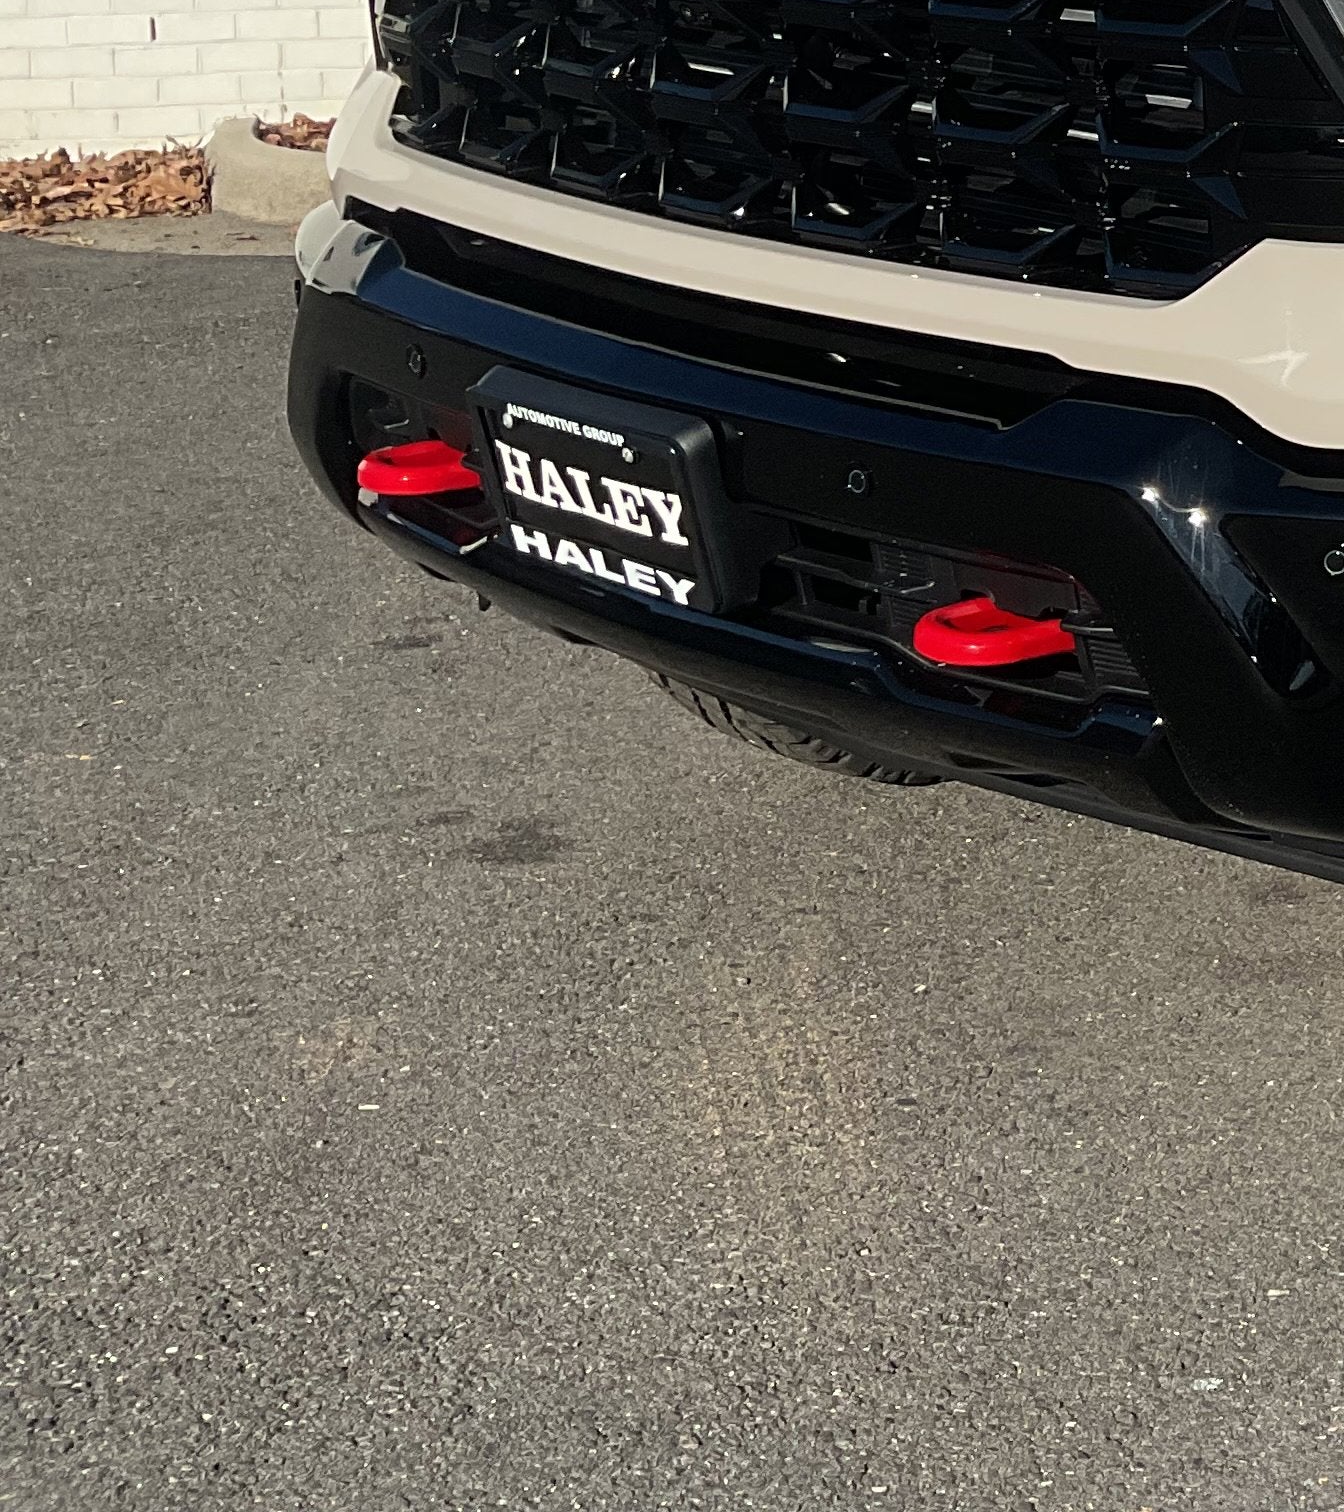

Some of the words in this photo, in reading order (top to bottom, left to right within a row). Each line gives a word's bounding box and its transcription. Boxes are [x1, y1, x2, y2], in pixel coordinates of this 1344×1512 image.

[507, 402, 582, 436] AUTOMOTIVE
[582, 424, 625, 448] GROUP
[494, 438, 690, 547] HALEY
[510, 524, 696, 606] HALEY
